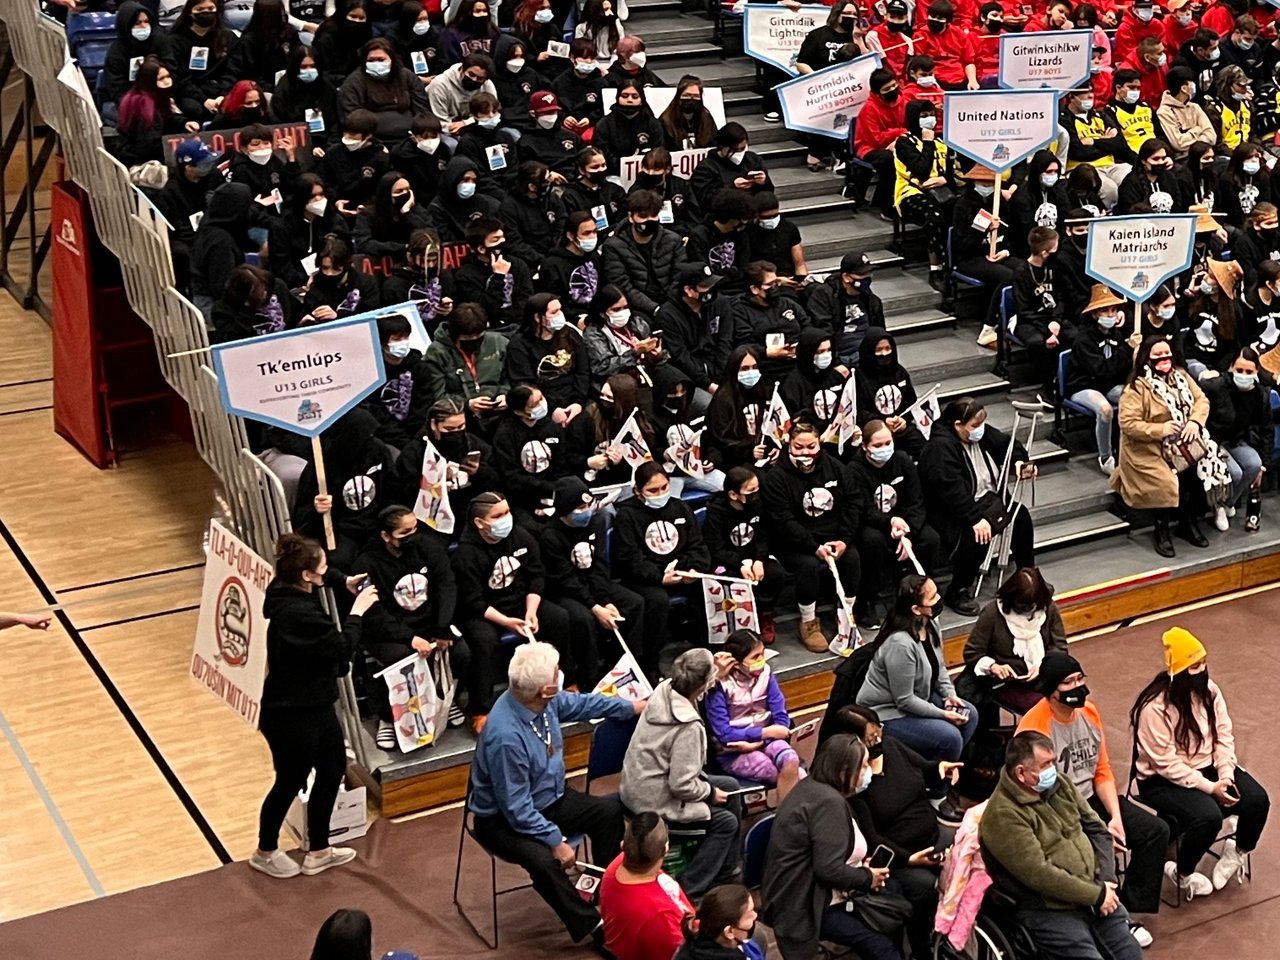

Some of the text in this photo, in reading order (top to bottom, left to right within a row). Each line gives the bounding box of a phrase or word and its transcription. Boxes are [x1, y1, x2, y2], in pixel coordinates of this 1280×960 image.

[769, 16, 816, 28] Gitmidiik
[1029, 55, 1063, 68] Lizards
[1028, 68, 1062, 76] U17 BOYS
[807, 73, 856, 96] Gitmidiik
[806, 83, 863, 107] Hurricanes
[834, 96, 855, 107] BOYS
[957, 108, 1045, 123] United Nations
[980, 127, 1022, 137] U17 GIRLS
[1109, 226, 1175, 241] Kaien Island
[1111, 239, 1168, 254] Matriarchs
[1120, 254, 1158, 263] U17 GIRLS
[256, 350, 343, 376] Tk'emlúps
[274, 375, 333, 393] U13 GIRLS
[1071, 744, 1098, 765] CHILD
